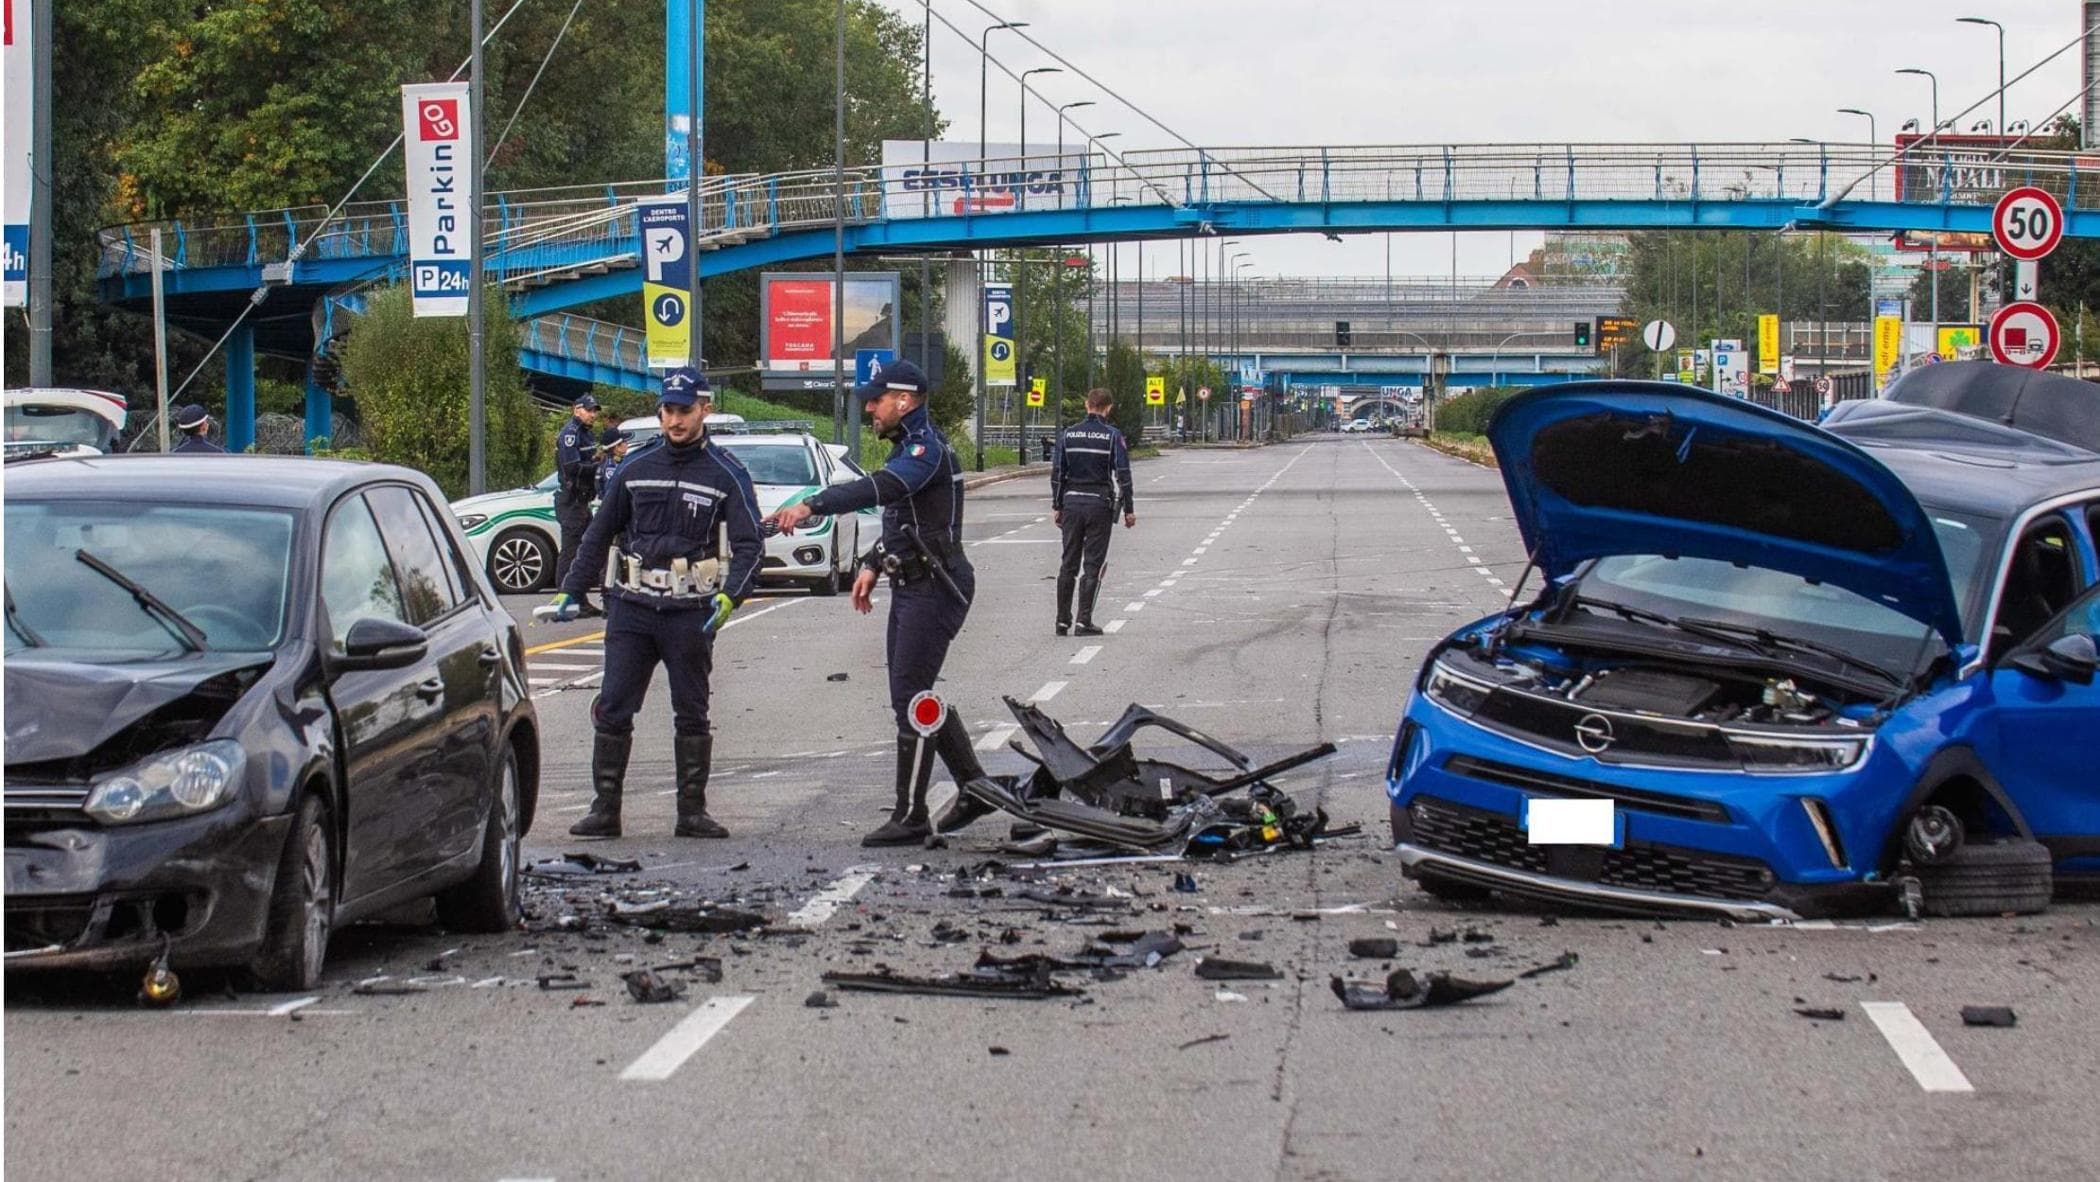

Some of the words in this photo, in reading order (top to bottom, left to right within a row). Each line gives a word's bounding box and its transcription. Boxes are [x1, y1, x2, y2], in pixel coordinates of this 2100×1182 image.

[2008, 207, 2048, 241] 50
[645, 227, 685, 281] P
[440, 271, 469, 290] 24h
[988, 301, 1010, 334] P
[1149, 379, 1162, 387] ALT
[1818, 381, 1828, 390] 50
[1088, 432, 1110, 440] LOCALE
